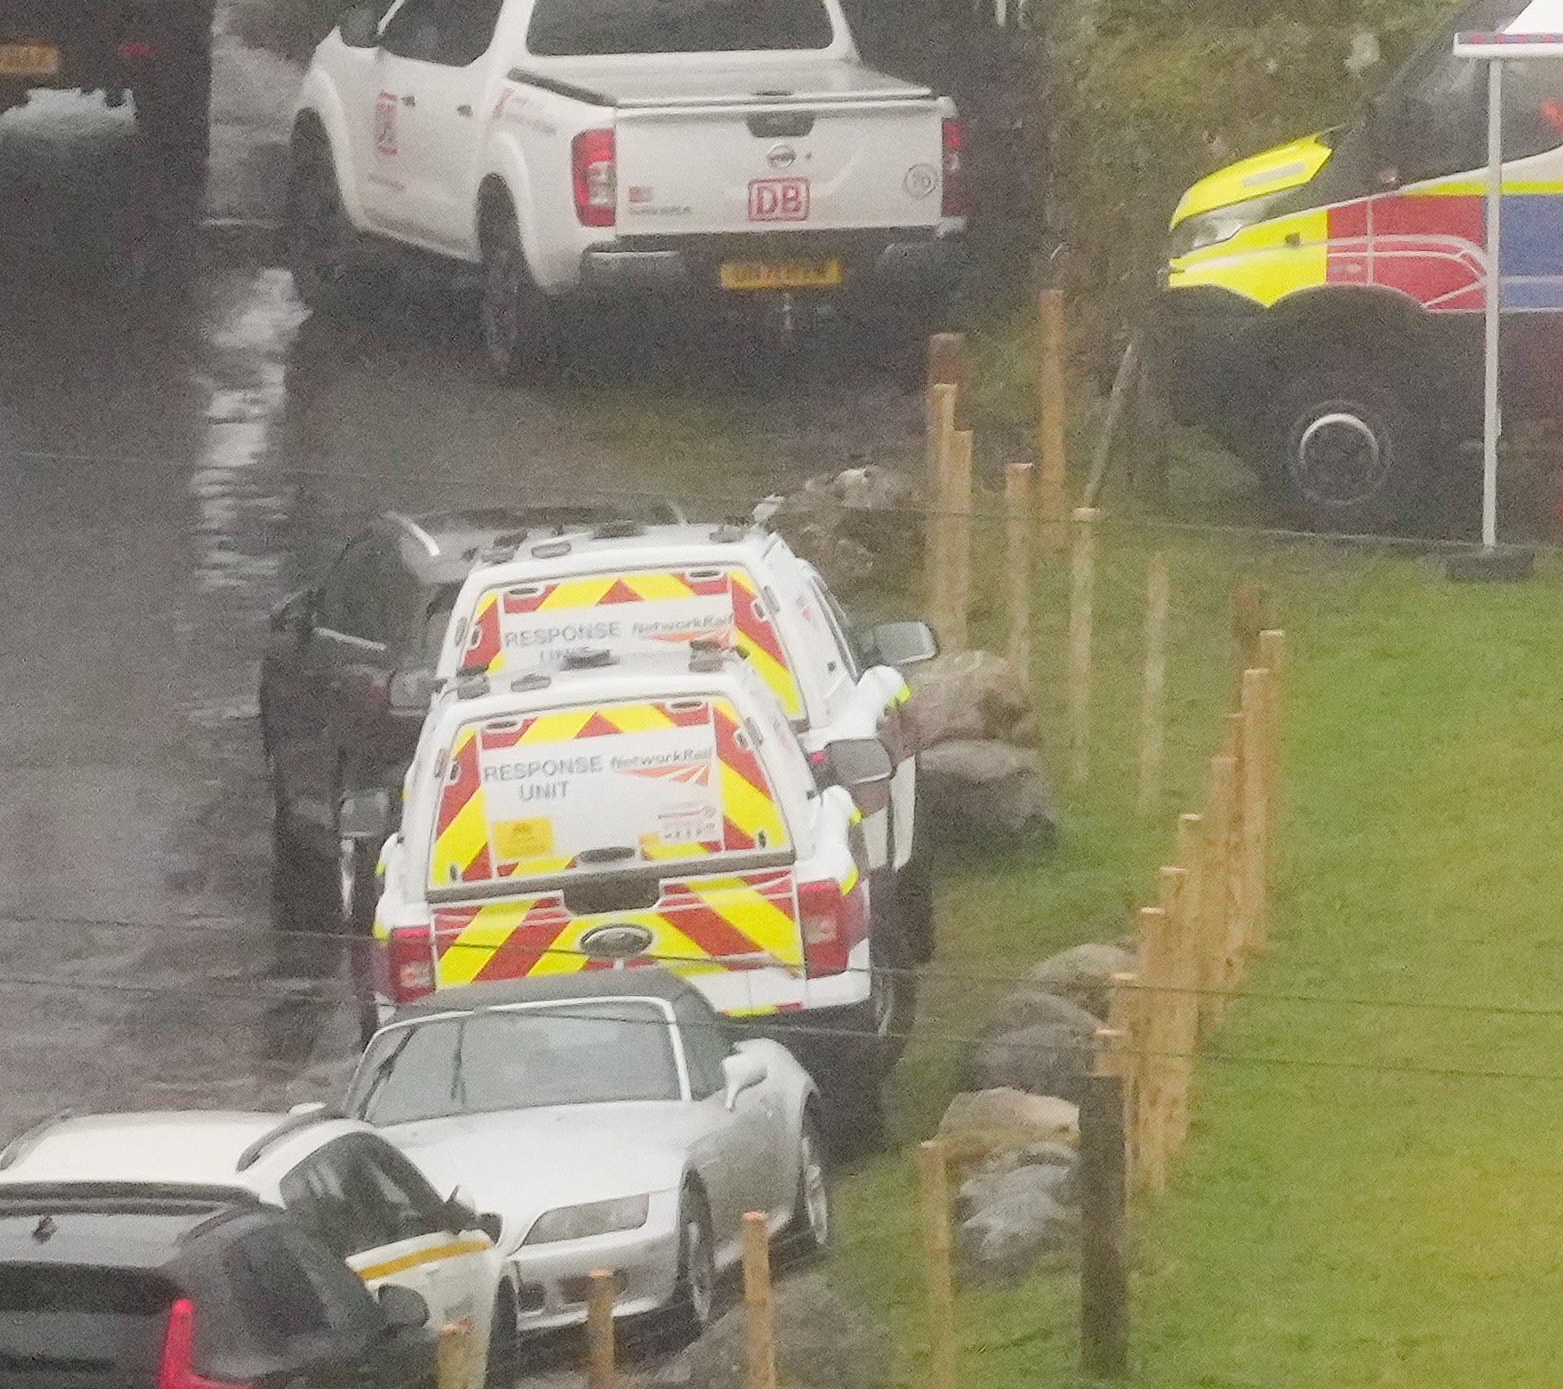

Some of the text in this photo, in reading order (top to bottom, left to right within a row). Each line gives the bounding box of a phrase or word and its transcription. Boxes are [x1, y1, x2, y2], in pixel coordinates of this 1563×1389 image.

[755, 184, 803, 215] DB
[504, 620, 621, 648] RESPONSE
[483, 755, 604, 783] RESPONSE
[519, 780, 570, 802] UNIT
